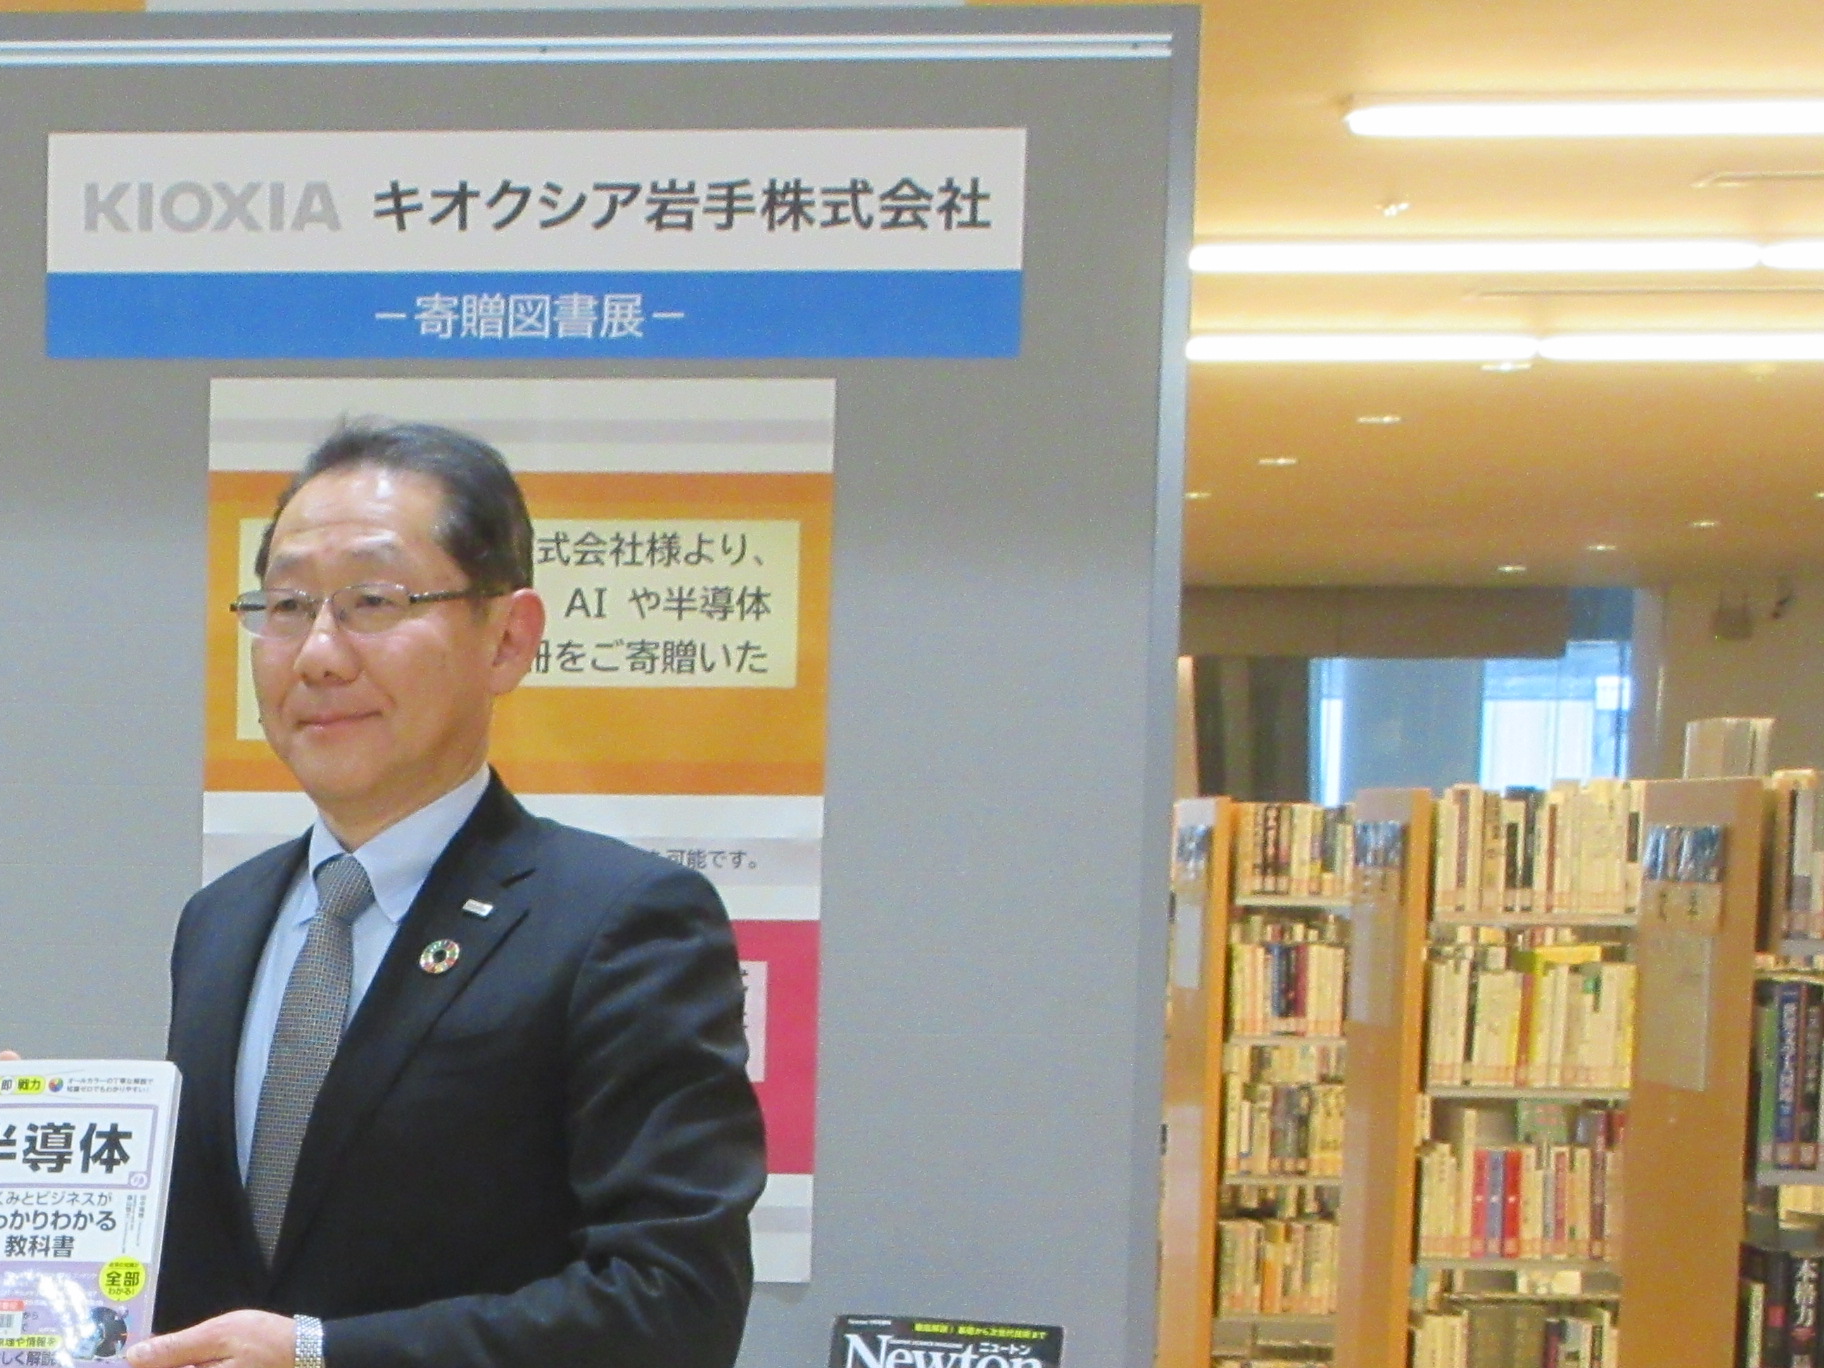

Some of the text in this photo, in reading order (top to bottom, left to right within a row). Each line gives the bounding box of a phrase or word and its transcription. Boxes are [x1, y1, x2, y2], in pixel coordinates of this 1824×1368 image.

[82, 178, 993, 233] KIOXIA キオクシア岩手株式会社
[564, 586, 772, 621] AI や半導体
[650, 849, 758, 870] 可能です。
[130, 1173, 149, 1188] の
[5, 1235, 76, 1258] 教科書
[106, 1271, 140, 1287] 全部
[978, 1342, 1031, 1356] ニュートン
